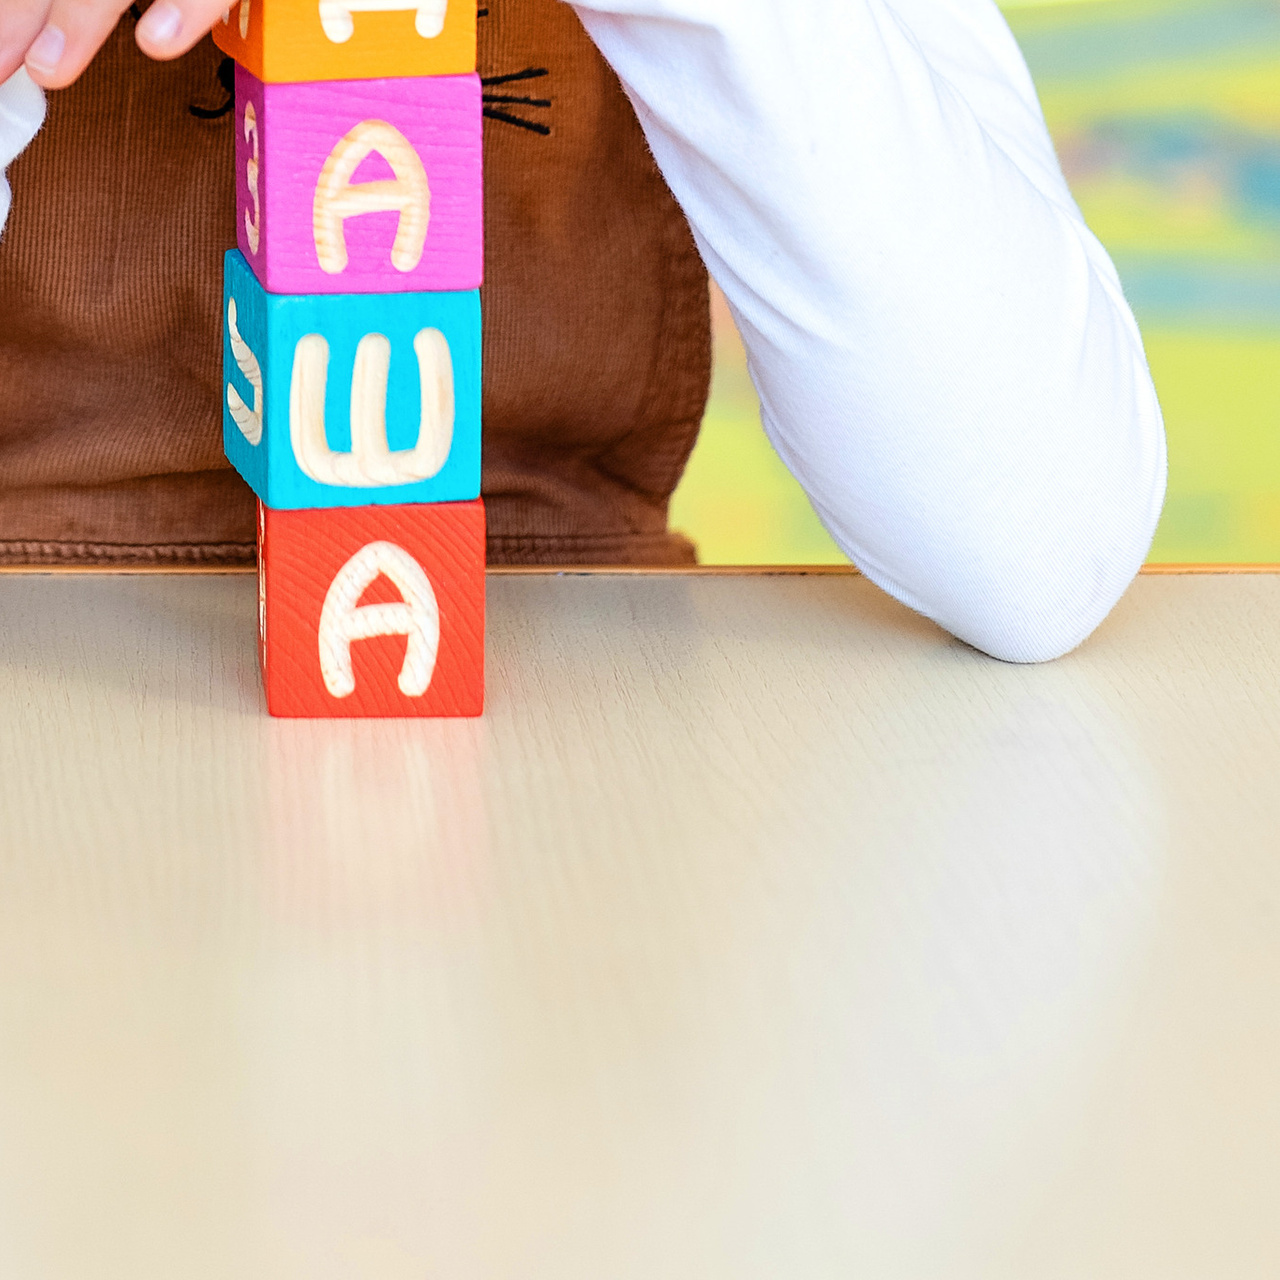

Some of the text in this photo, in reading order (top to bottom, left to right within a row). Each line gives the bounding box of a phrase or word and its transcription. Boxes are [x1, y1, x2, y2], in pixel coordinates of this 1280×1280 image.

[313, 118, 432, 274] А
[289, 326, 455, 488] Ш
[319, 540, 440, 698] А
